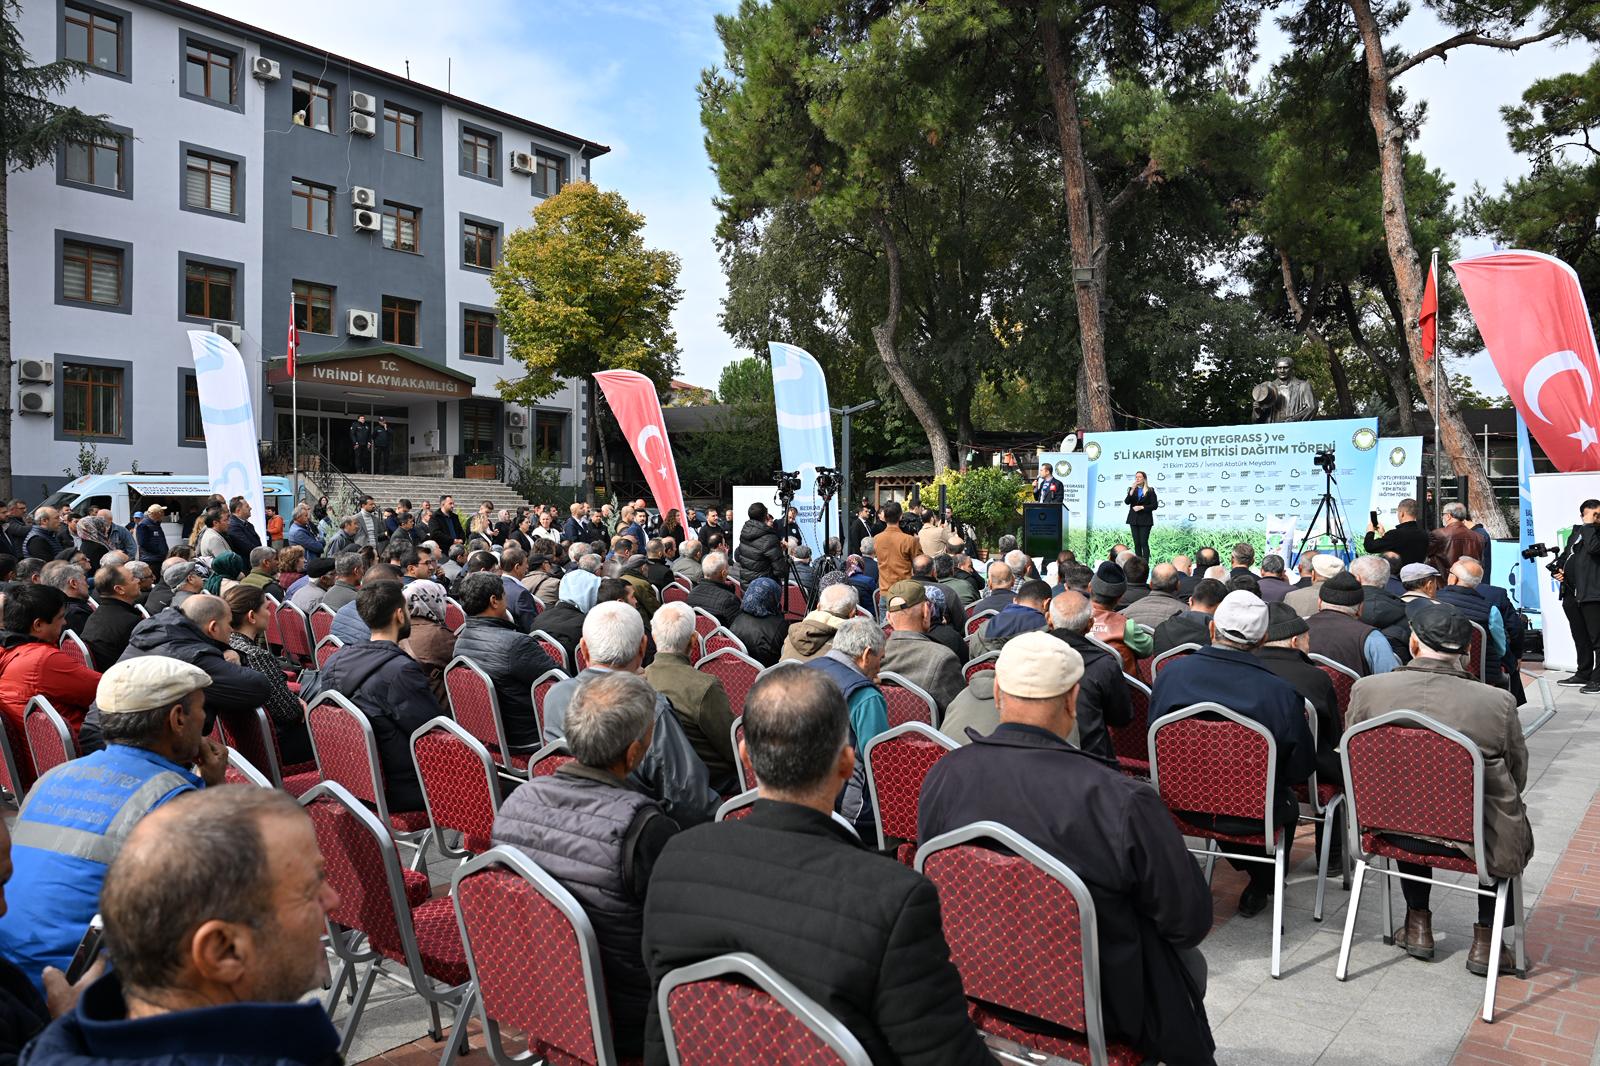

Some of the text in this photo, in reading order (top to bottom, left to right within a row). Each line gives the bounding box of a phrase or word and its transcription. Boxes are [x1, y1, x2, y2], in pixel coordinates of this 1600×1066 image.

[380, 360, 399, 372] T.C.
[312, 364, 458, 393] İVRİNDİ KAYMAKAMLIĞI
[1155, 435, 1175, 447] SÜT
[1176, 436, 1198, 446] OTU
[1271, 434, 1285, 442] ve
[1132, 449, 1174, 461] KARIŞIM
[1176, 448, 1198, 458] YEM
[1201, 444, 1239, 457] BİTKİSİ
[1240, 443, 1289, 456] DAĞITIM
[1291, 440, 1336, 454] TÖRENİ
[1248, 459, 1277, 468] Meydanı
